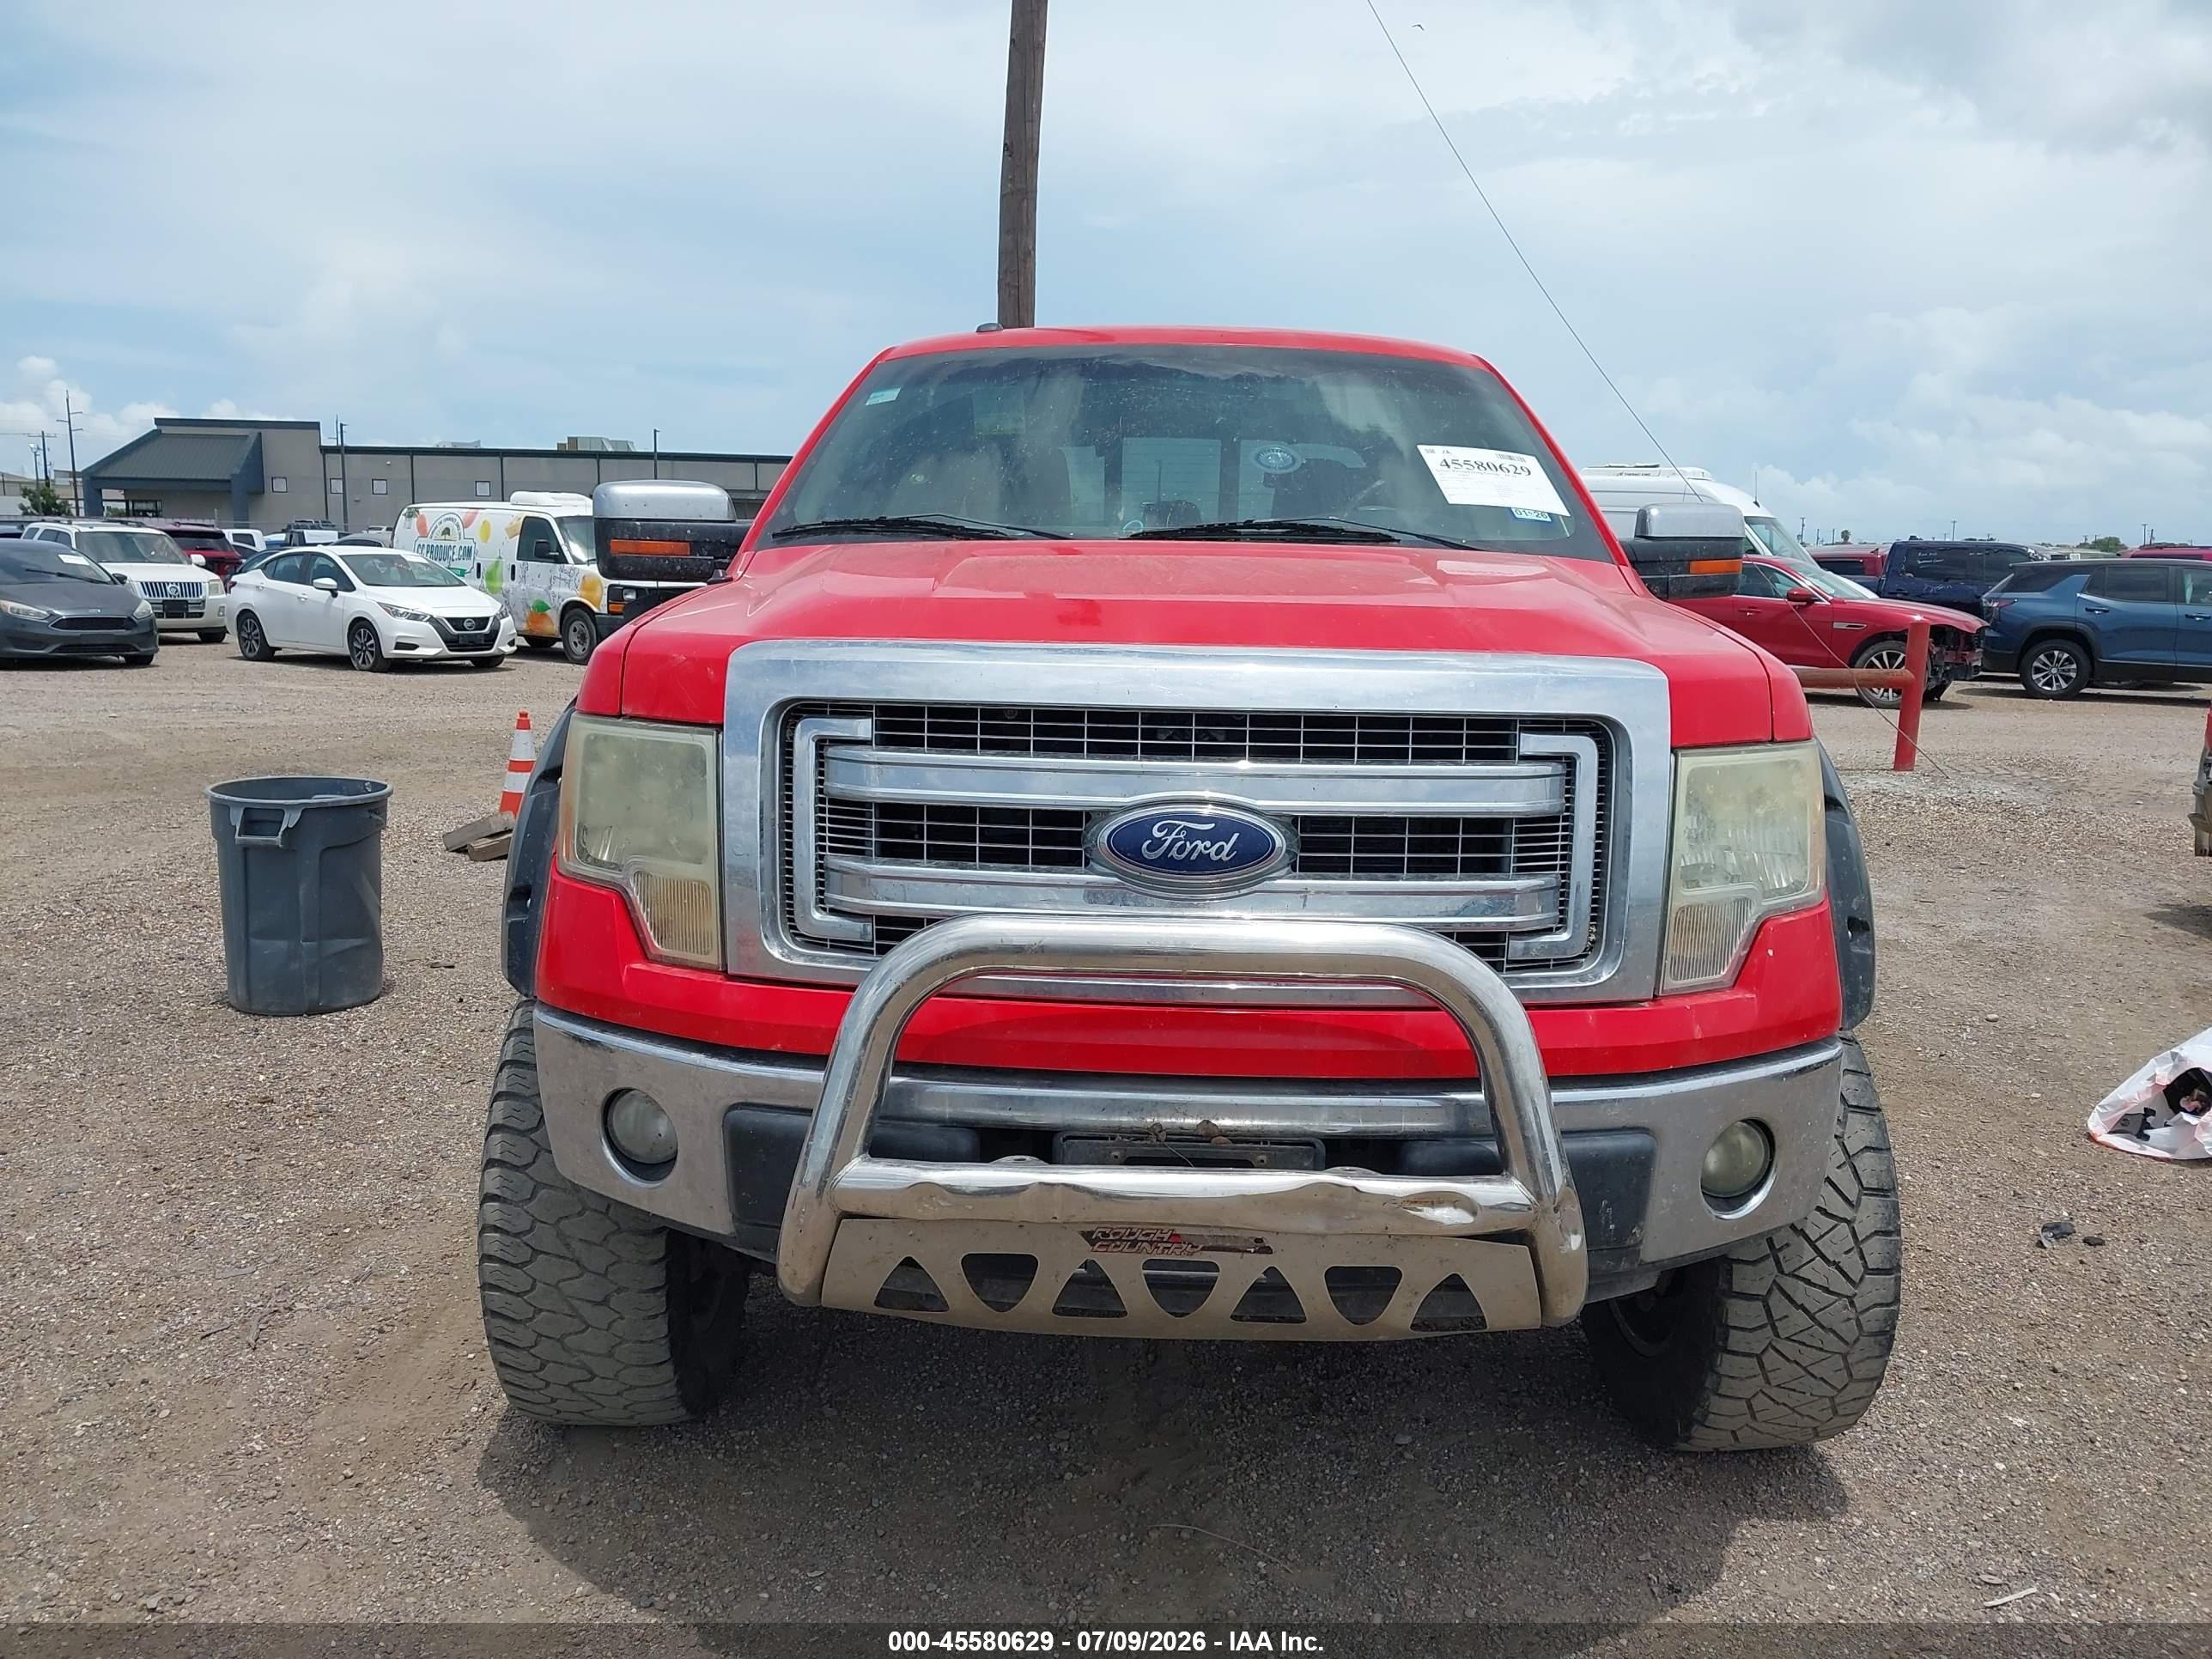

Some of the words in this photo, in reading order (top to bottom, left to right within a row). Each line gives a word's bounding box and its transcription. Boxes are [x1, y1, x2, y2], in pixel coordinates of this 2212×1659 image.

[1439, 458, 1532, 477] 45580629
[1142, 820, 1239, 861] Ford
[1091, 1227, 1174, 1242] ROUGH
[1091, 1241, 1203, 1255] COUNTRY
